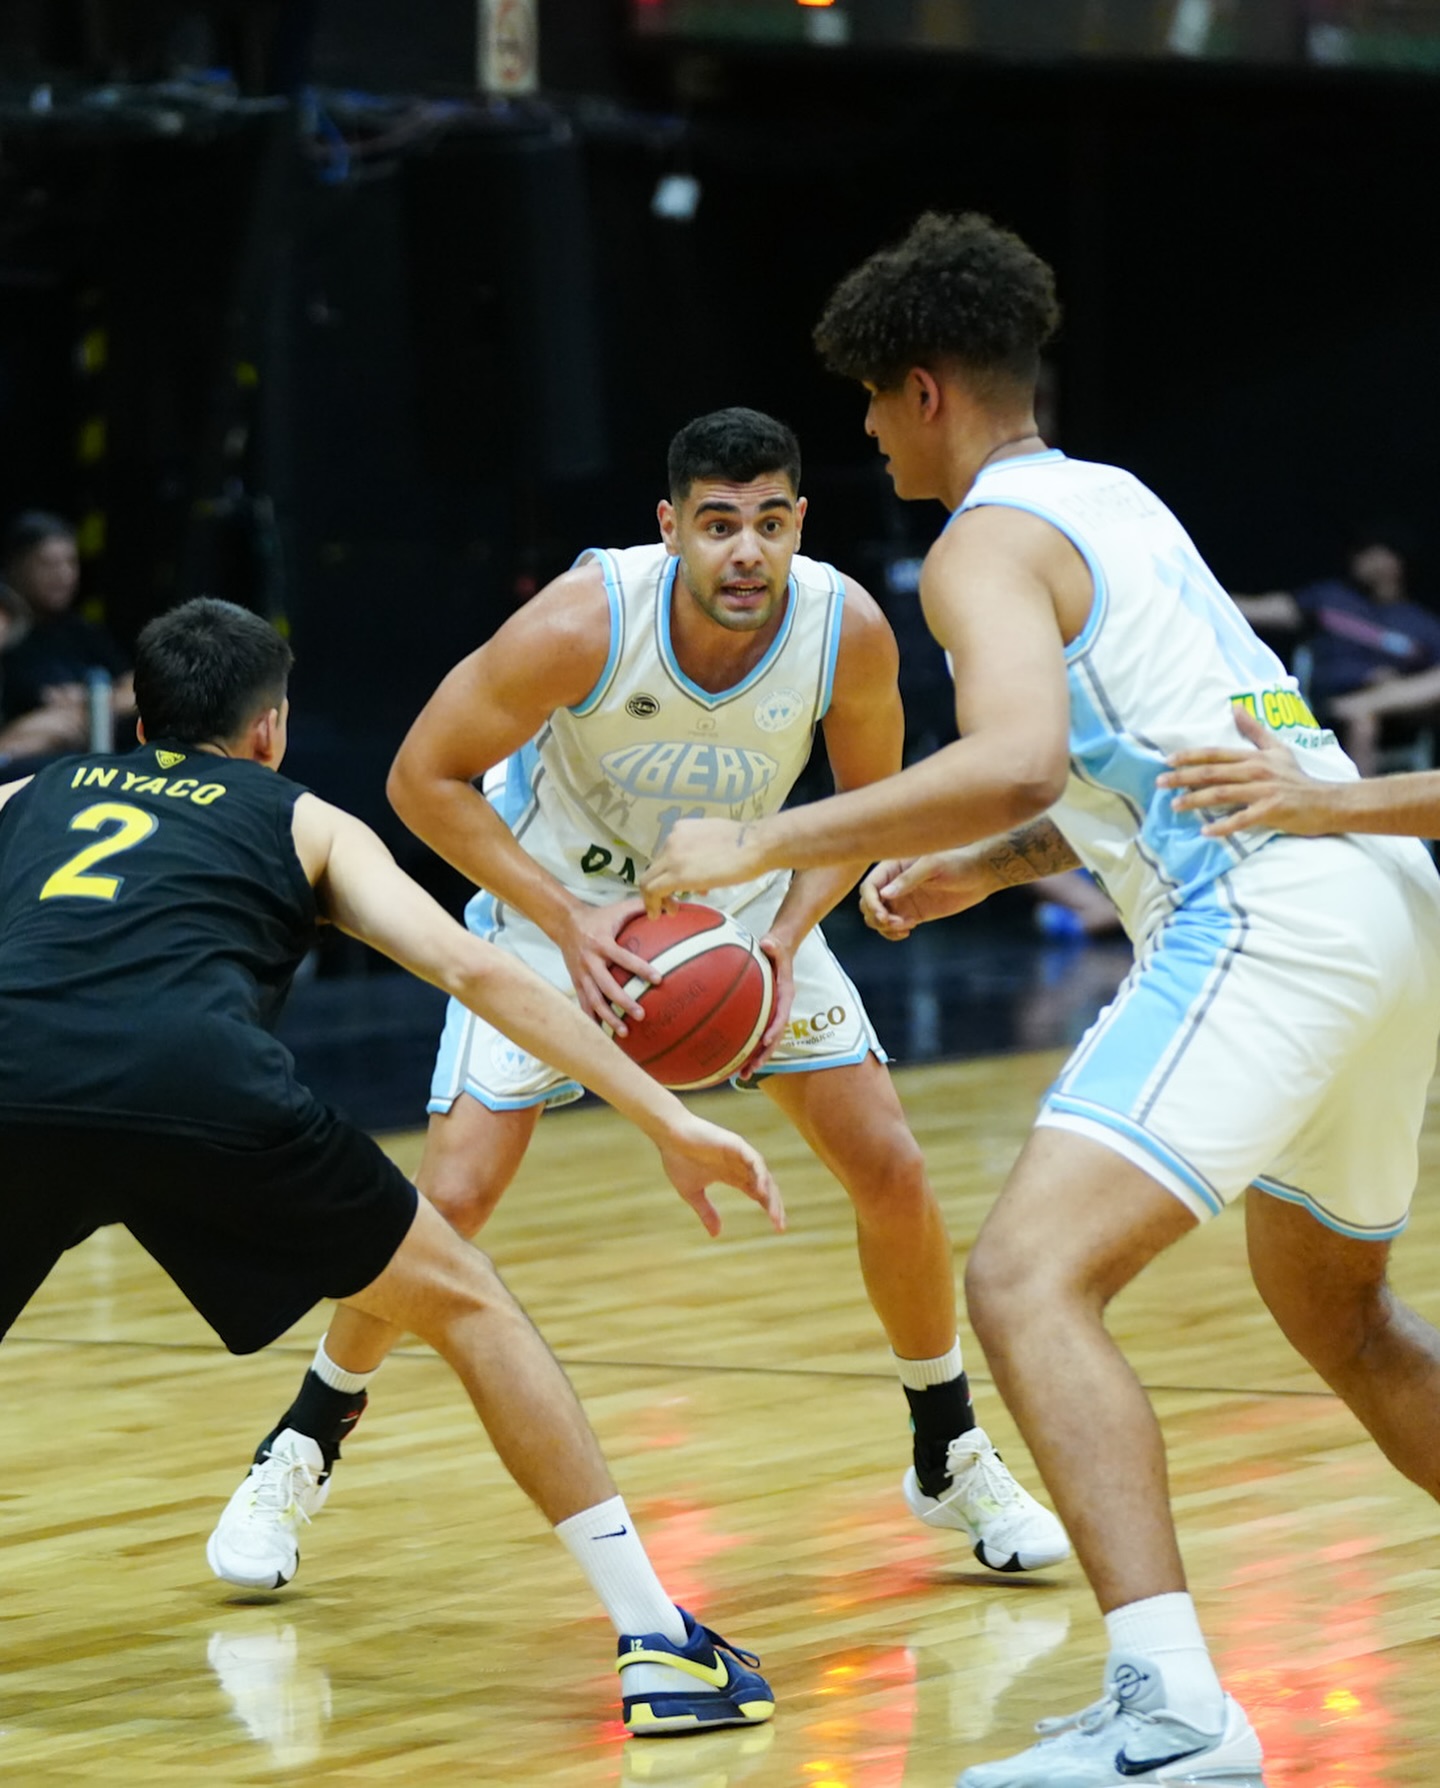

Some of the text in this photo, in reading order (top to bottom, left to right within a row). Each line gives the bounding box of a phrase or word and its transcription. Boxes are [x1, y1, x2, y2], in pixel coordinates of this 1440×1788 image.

[71, 767, 227, 806] INYACO
[39, 802, 159, 902] 2
[652, 805, 706, 858] 1
[630, 1638, 645, 1653] 12
